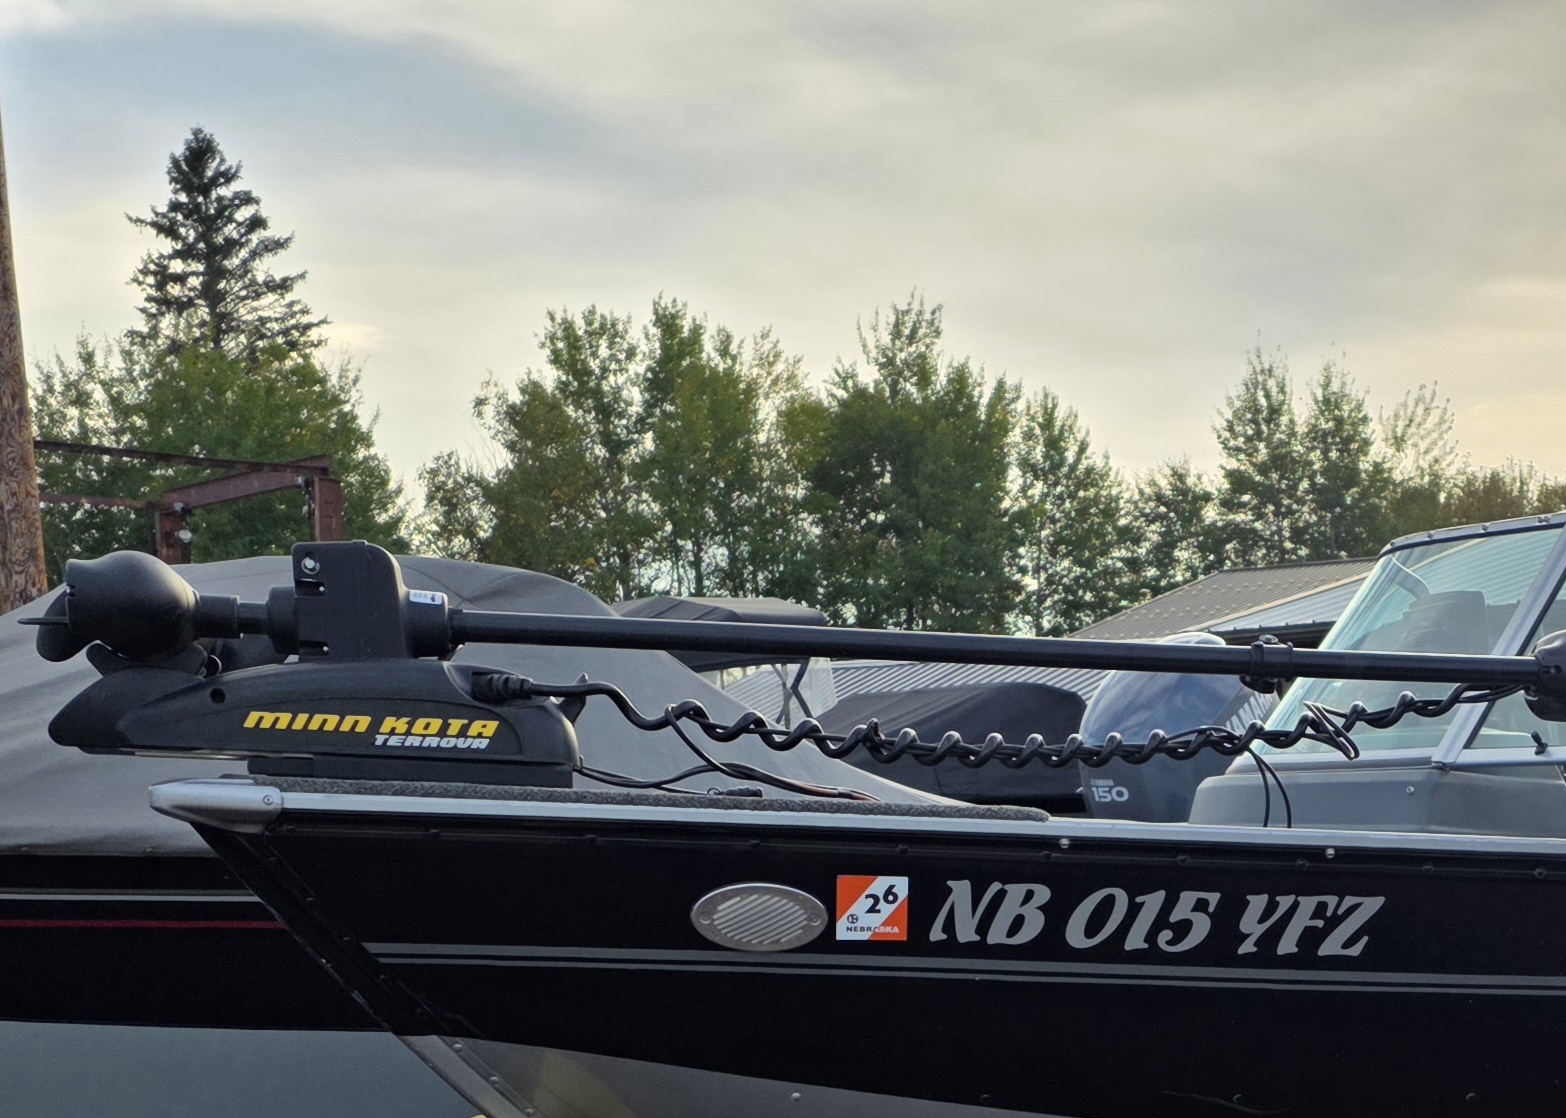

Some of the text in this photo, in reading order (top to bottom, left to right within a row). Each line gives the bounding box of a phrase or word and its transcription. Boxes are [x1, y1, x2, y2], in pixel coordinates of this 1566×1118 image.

[243, 711, 500, 737] MINN KOTA
[374, 734, 490, 749] TERROVA
[1090, 786, 1129, 802] 150
[864, 884, 899, 914] 26
[929, 879, 1386, 956] NB 015 YFZ
[846, 926, 900, 934] NEBRASKA
